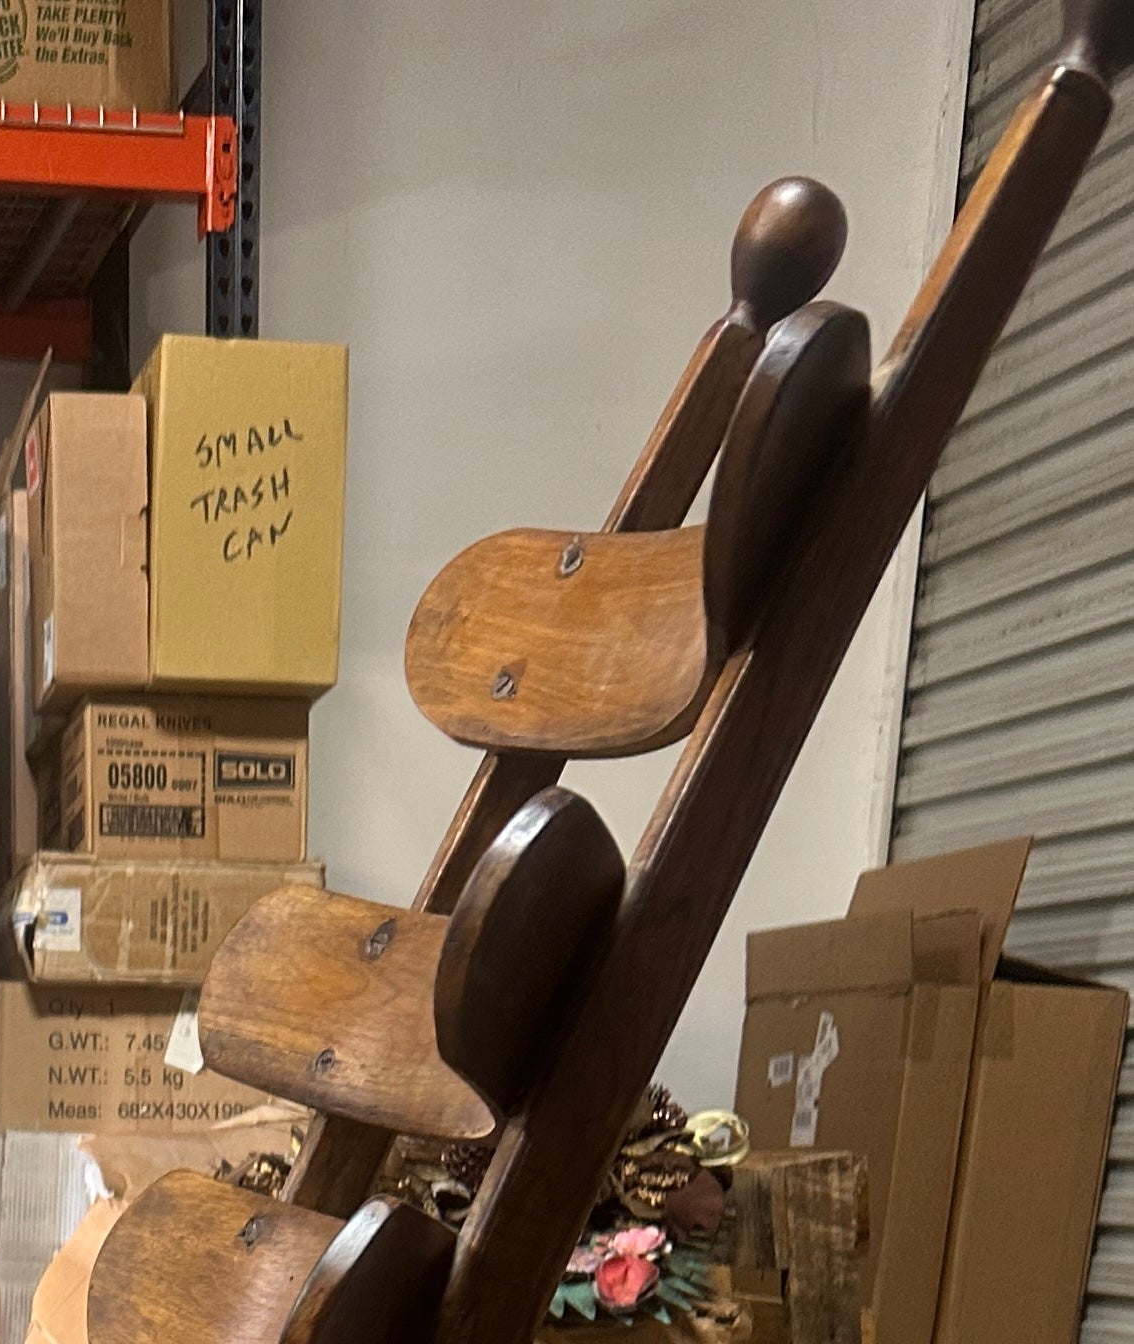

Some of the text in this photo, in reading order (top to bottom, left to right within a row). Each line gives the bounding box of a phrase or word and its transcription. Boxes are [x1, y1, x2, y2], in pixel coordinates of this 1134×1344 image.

[37, 6, 126, 26] TAKE PLENTY!
[36, 25, 134, 48] We'll Buy Back
[35, 47, 109, 66] the Extras.
[195, 416, 304, 469] SMALL
[190, 465, 290, 524] TRASH
[223, 509, 293, 563] CAN
[97, 713, 213, 732] REGAL KNIVES
[108, 762, 167, 790] 05800
[220, 759, 287, 781] SOLO
[125, 1033, 165, 1051] 7.45
[124, 1068, 151, 1086] 5.5
[162, 1069, 184, 1090] kg
[48, 1101, 102, 1120] Meas:
